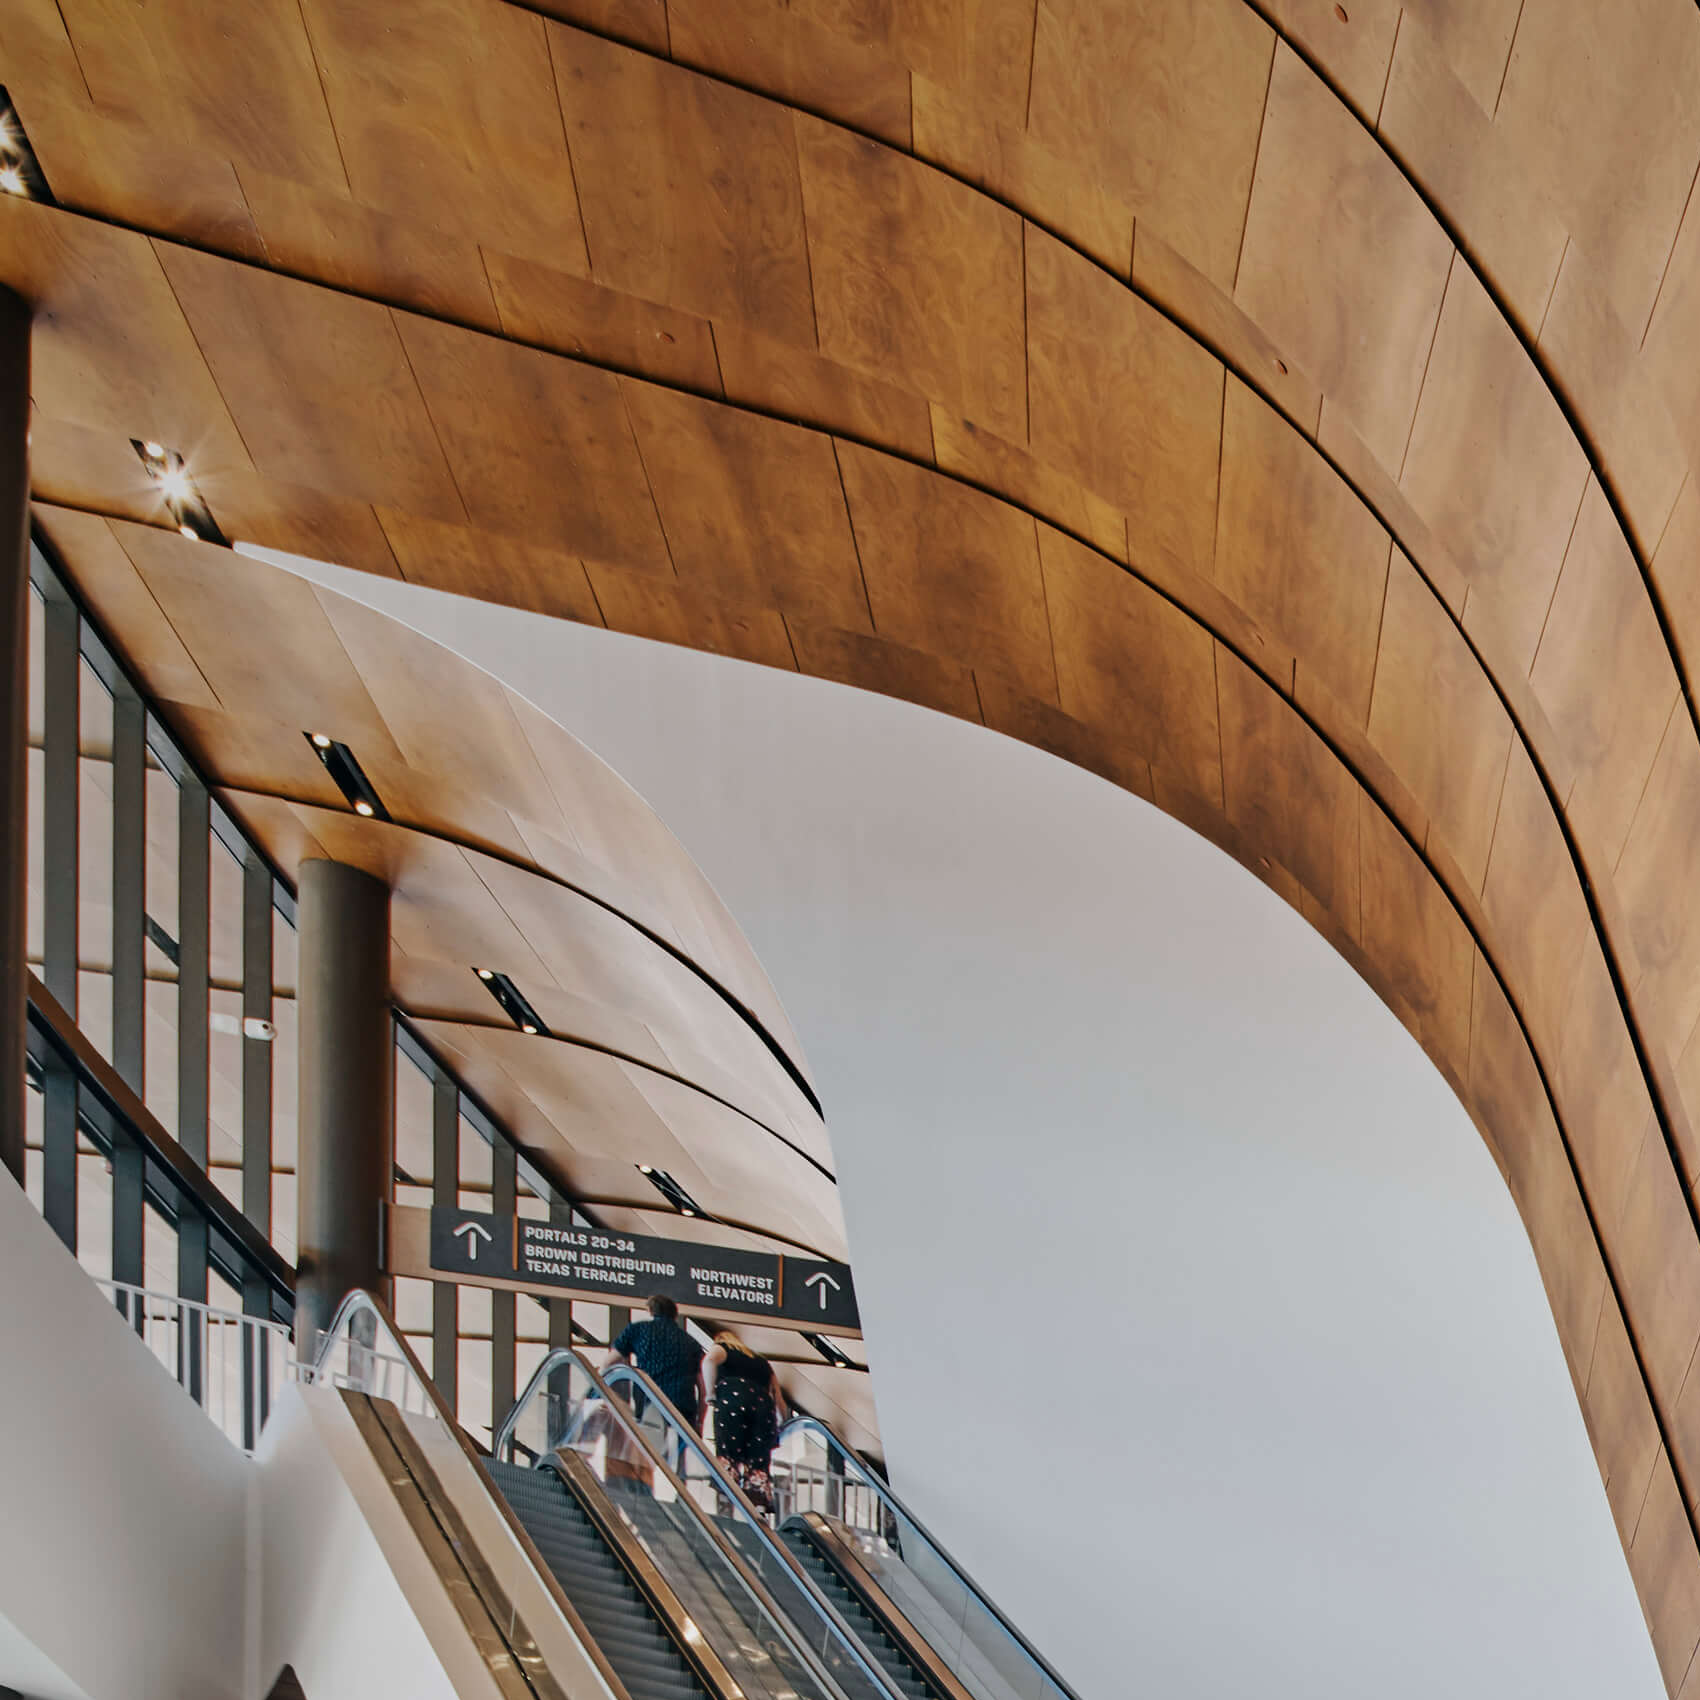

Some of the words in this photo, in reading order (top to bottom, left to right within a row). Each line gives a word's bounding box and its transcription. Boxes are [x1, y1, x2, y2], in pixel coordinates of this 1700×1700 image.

[525, 1226, 588, 1246] PORTALS
[591, 1233, 636, 1252] 20-34
[525, 1244, 577, 1262] BROWN
[581, 1252, 675, 1276] DISTRIBUTING
[526, 1259, 570, 1276] TEXAS
[574, 1266, 636, 1286] TERRACE
[690, 1268, 774, 1290] NORTHWEST
[697, 1283, 774, 1305] ELEVATORS
